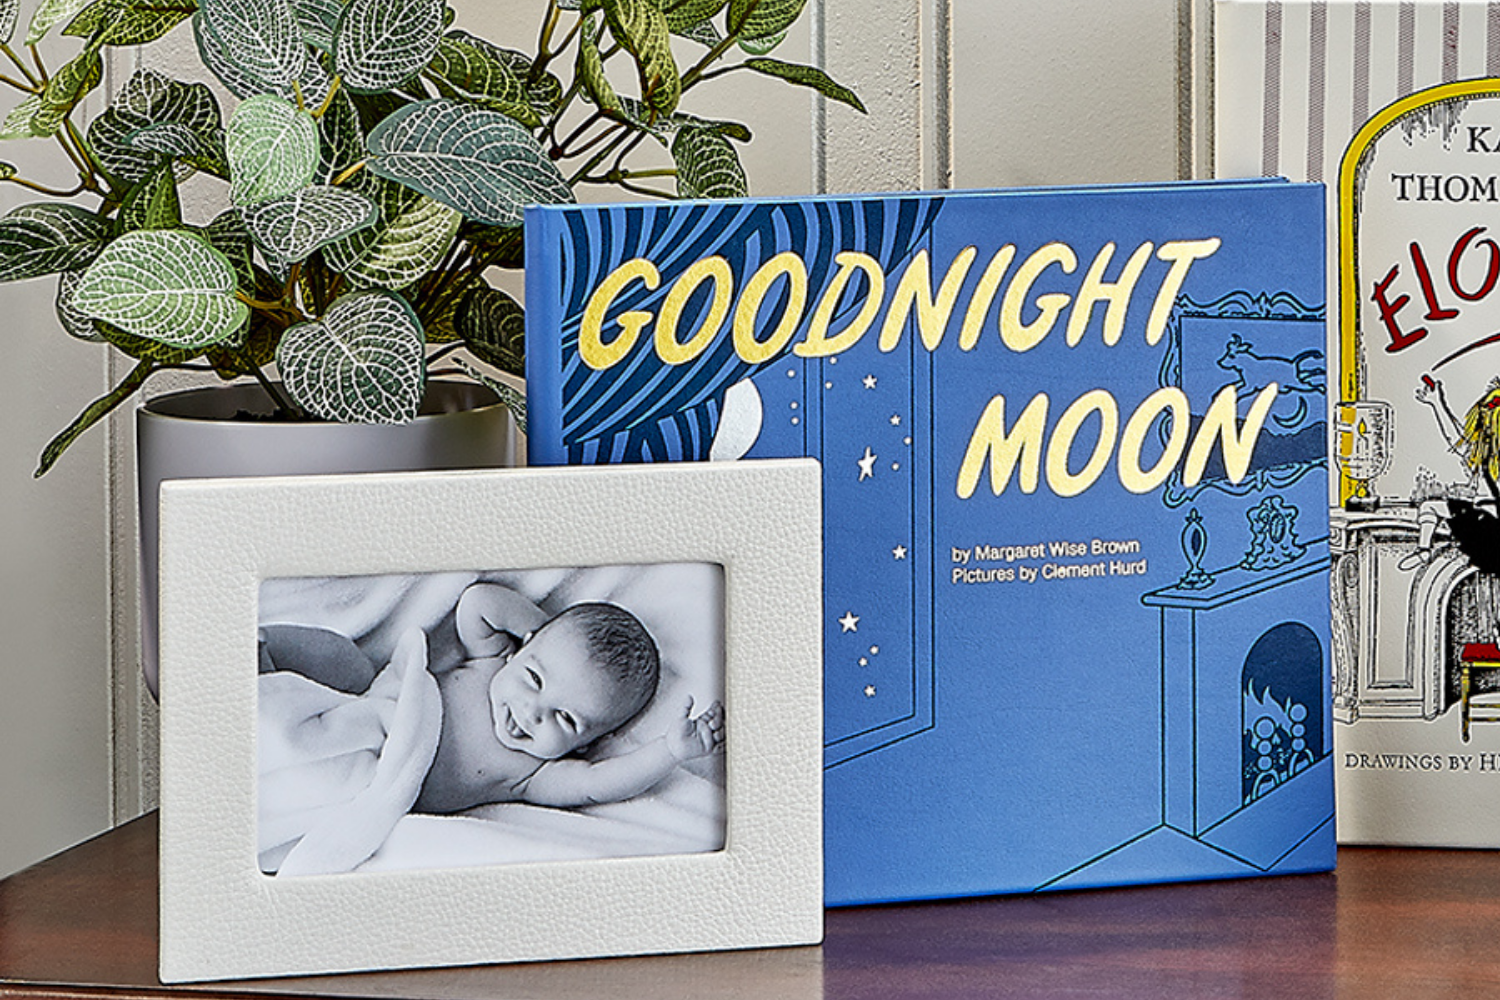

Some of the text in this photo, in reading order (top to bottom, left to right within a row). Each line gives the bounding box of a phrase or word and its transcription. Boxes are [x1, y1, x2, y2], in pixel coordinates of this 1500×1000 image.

[576, 237, 1222, 370] GOODNIGHT
[956, 382, 1280, 501] MOON
[952, 538, 1140, 564] by Margaret Wise Brown
[952, 559, 1147, 584] Pictures by Clement Hurd
[1344, 753, 1442, 771] DRAWINGS
[1448, 754, 1472, 771] BY
